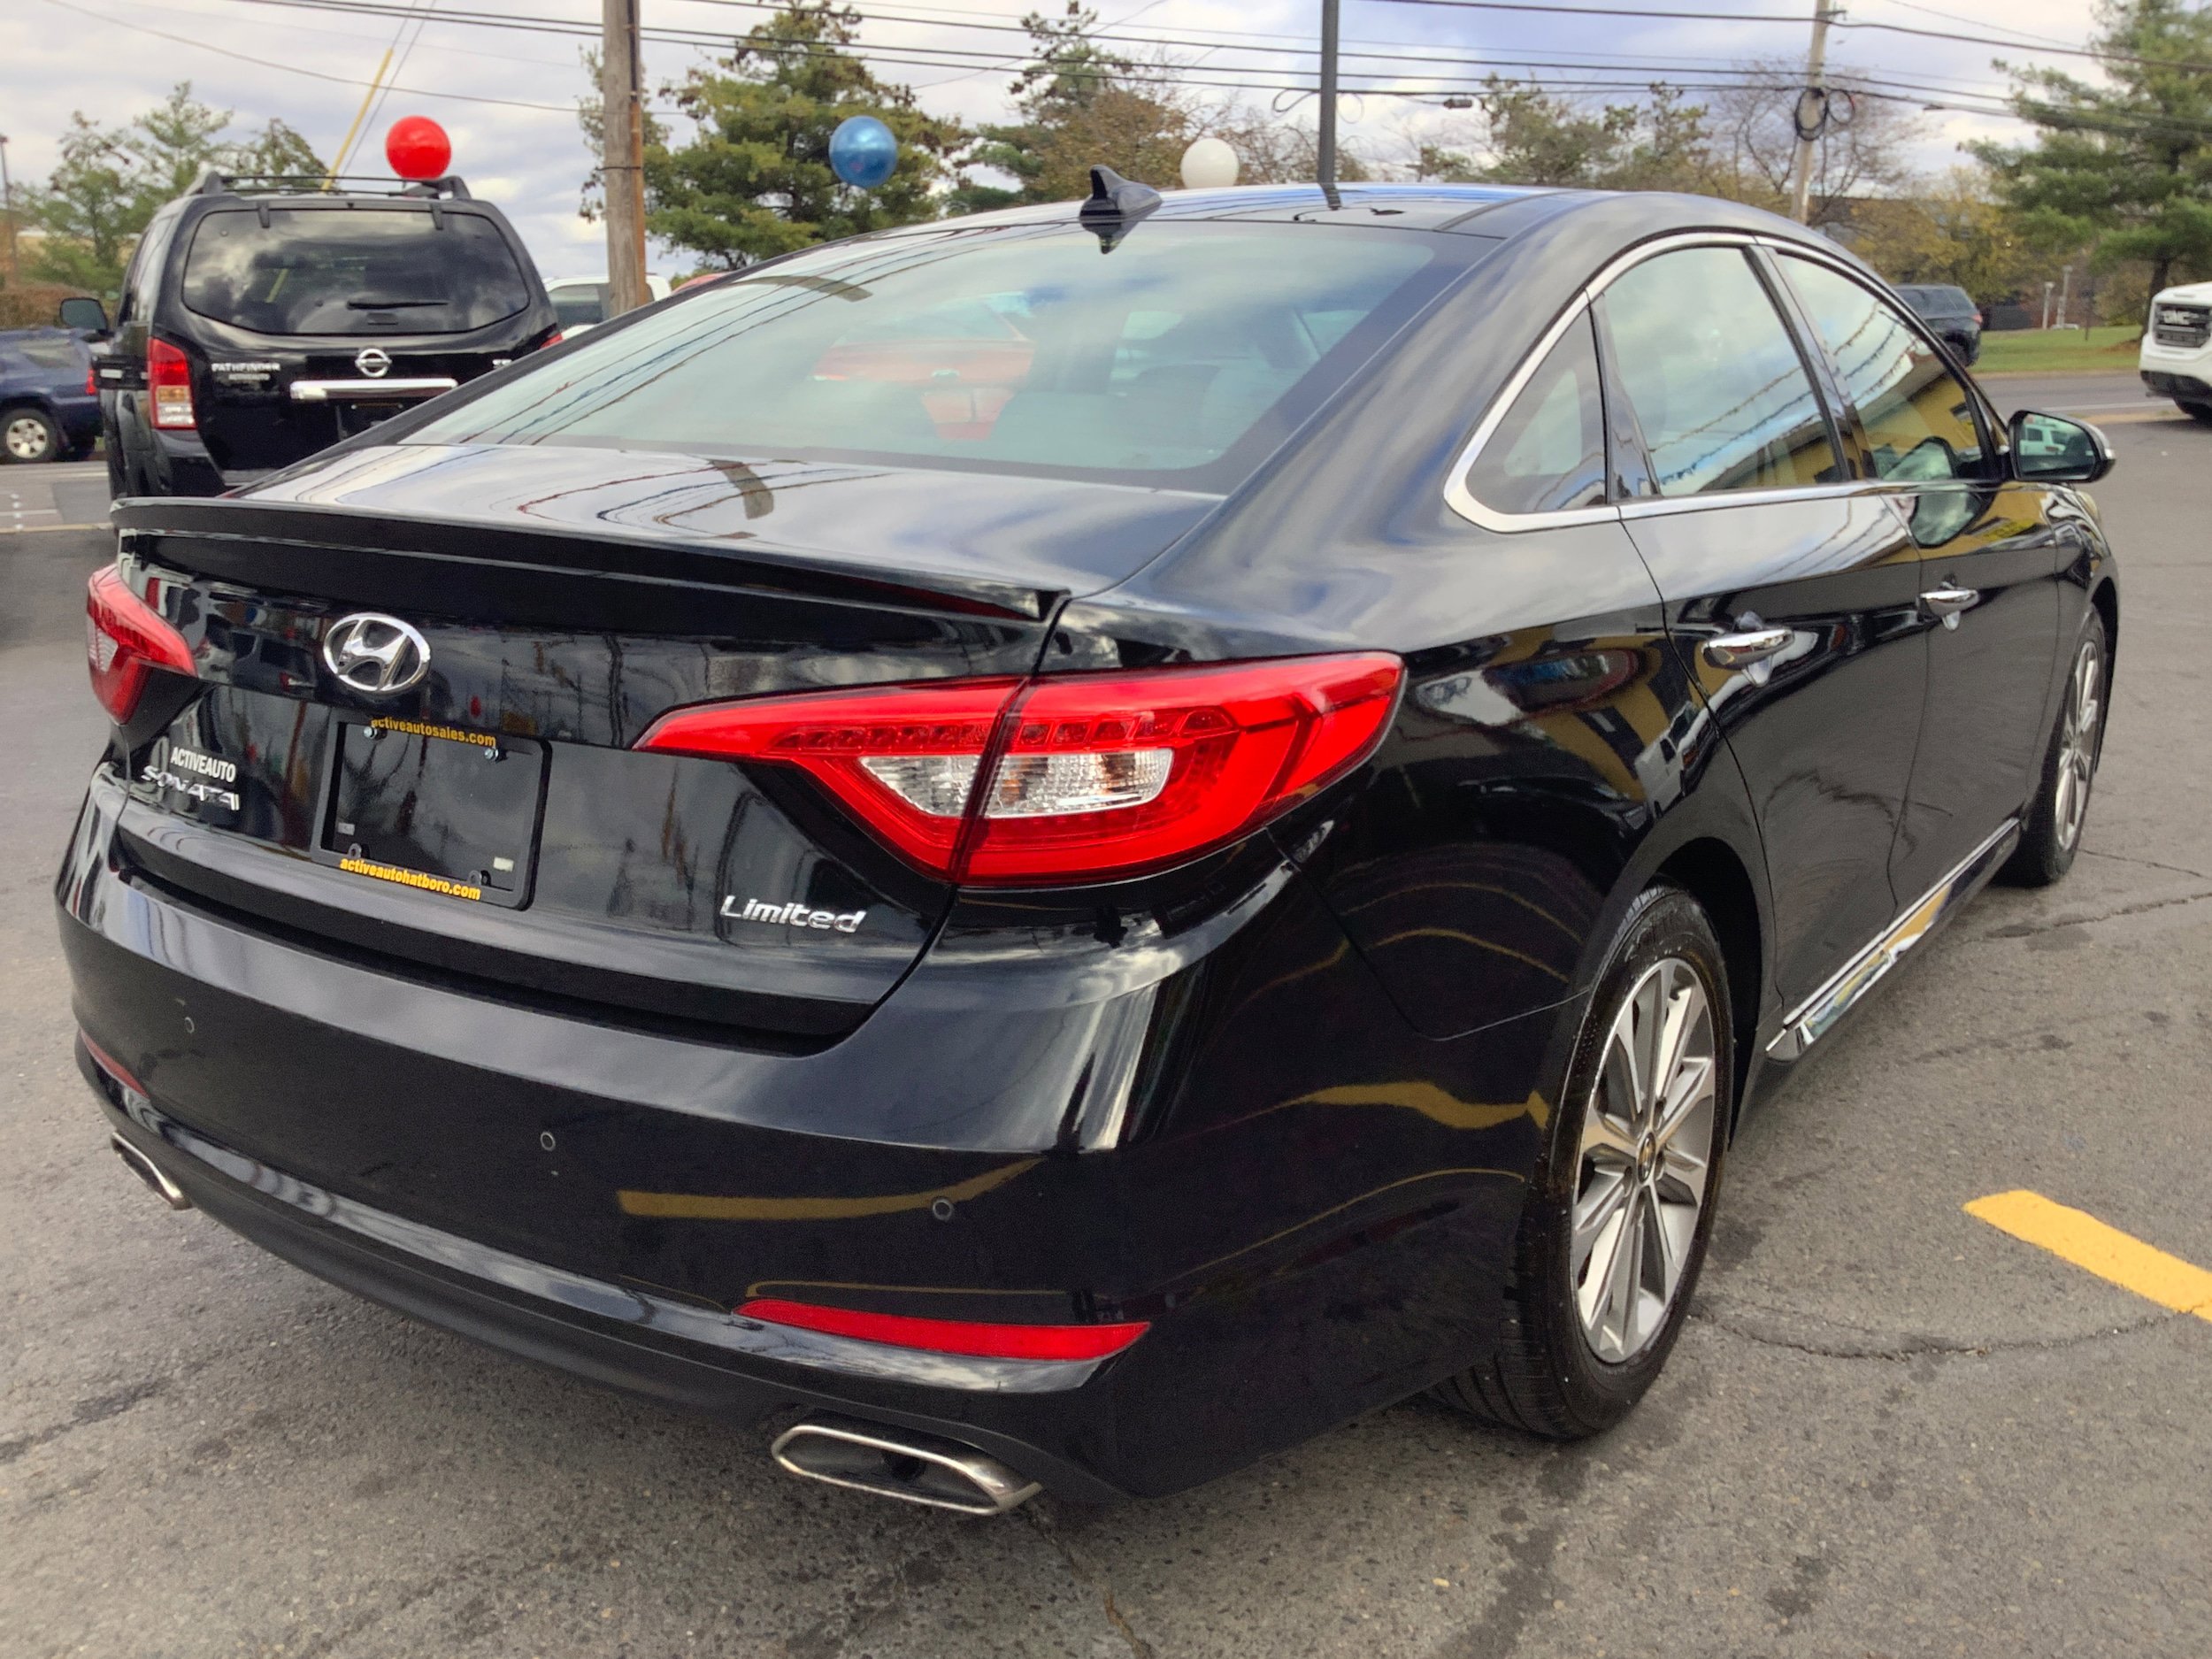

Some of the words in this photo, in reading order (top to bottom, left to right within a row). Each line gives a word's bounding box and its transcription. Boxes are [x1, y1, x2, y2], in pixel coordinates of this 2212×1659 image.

[371, 717, 496, 748] activeautosales.com
[171, 747, 236, 783] ACTIVEAUTO
[141, 765, 240, 810] SONATA
[340, 857, 481, 901] activeautohatboro.com
[719, 895, 867, 933] Limited
